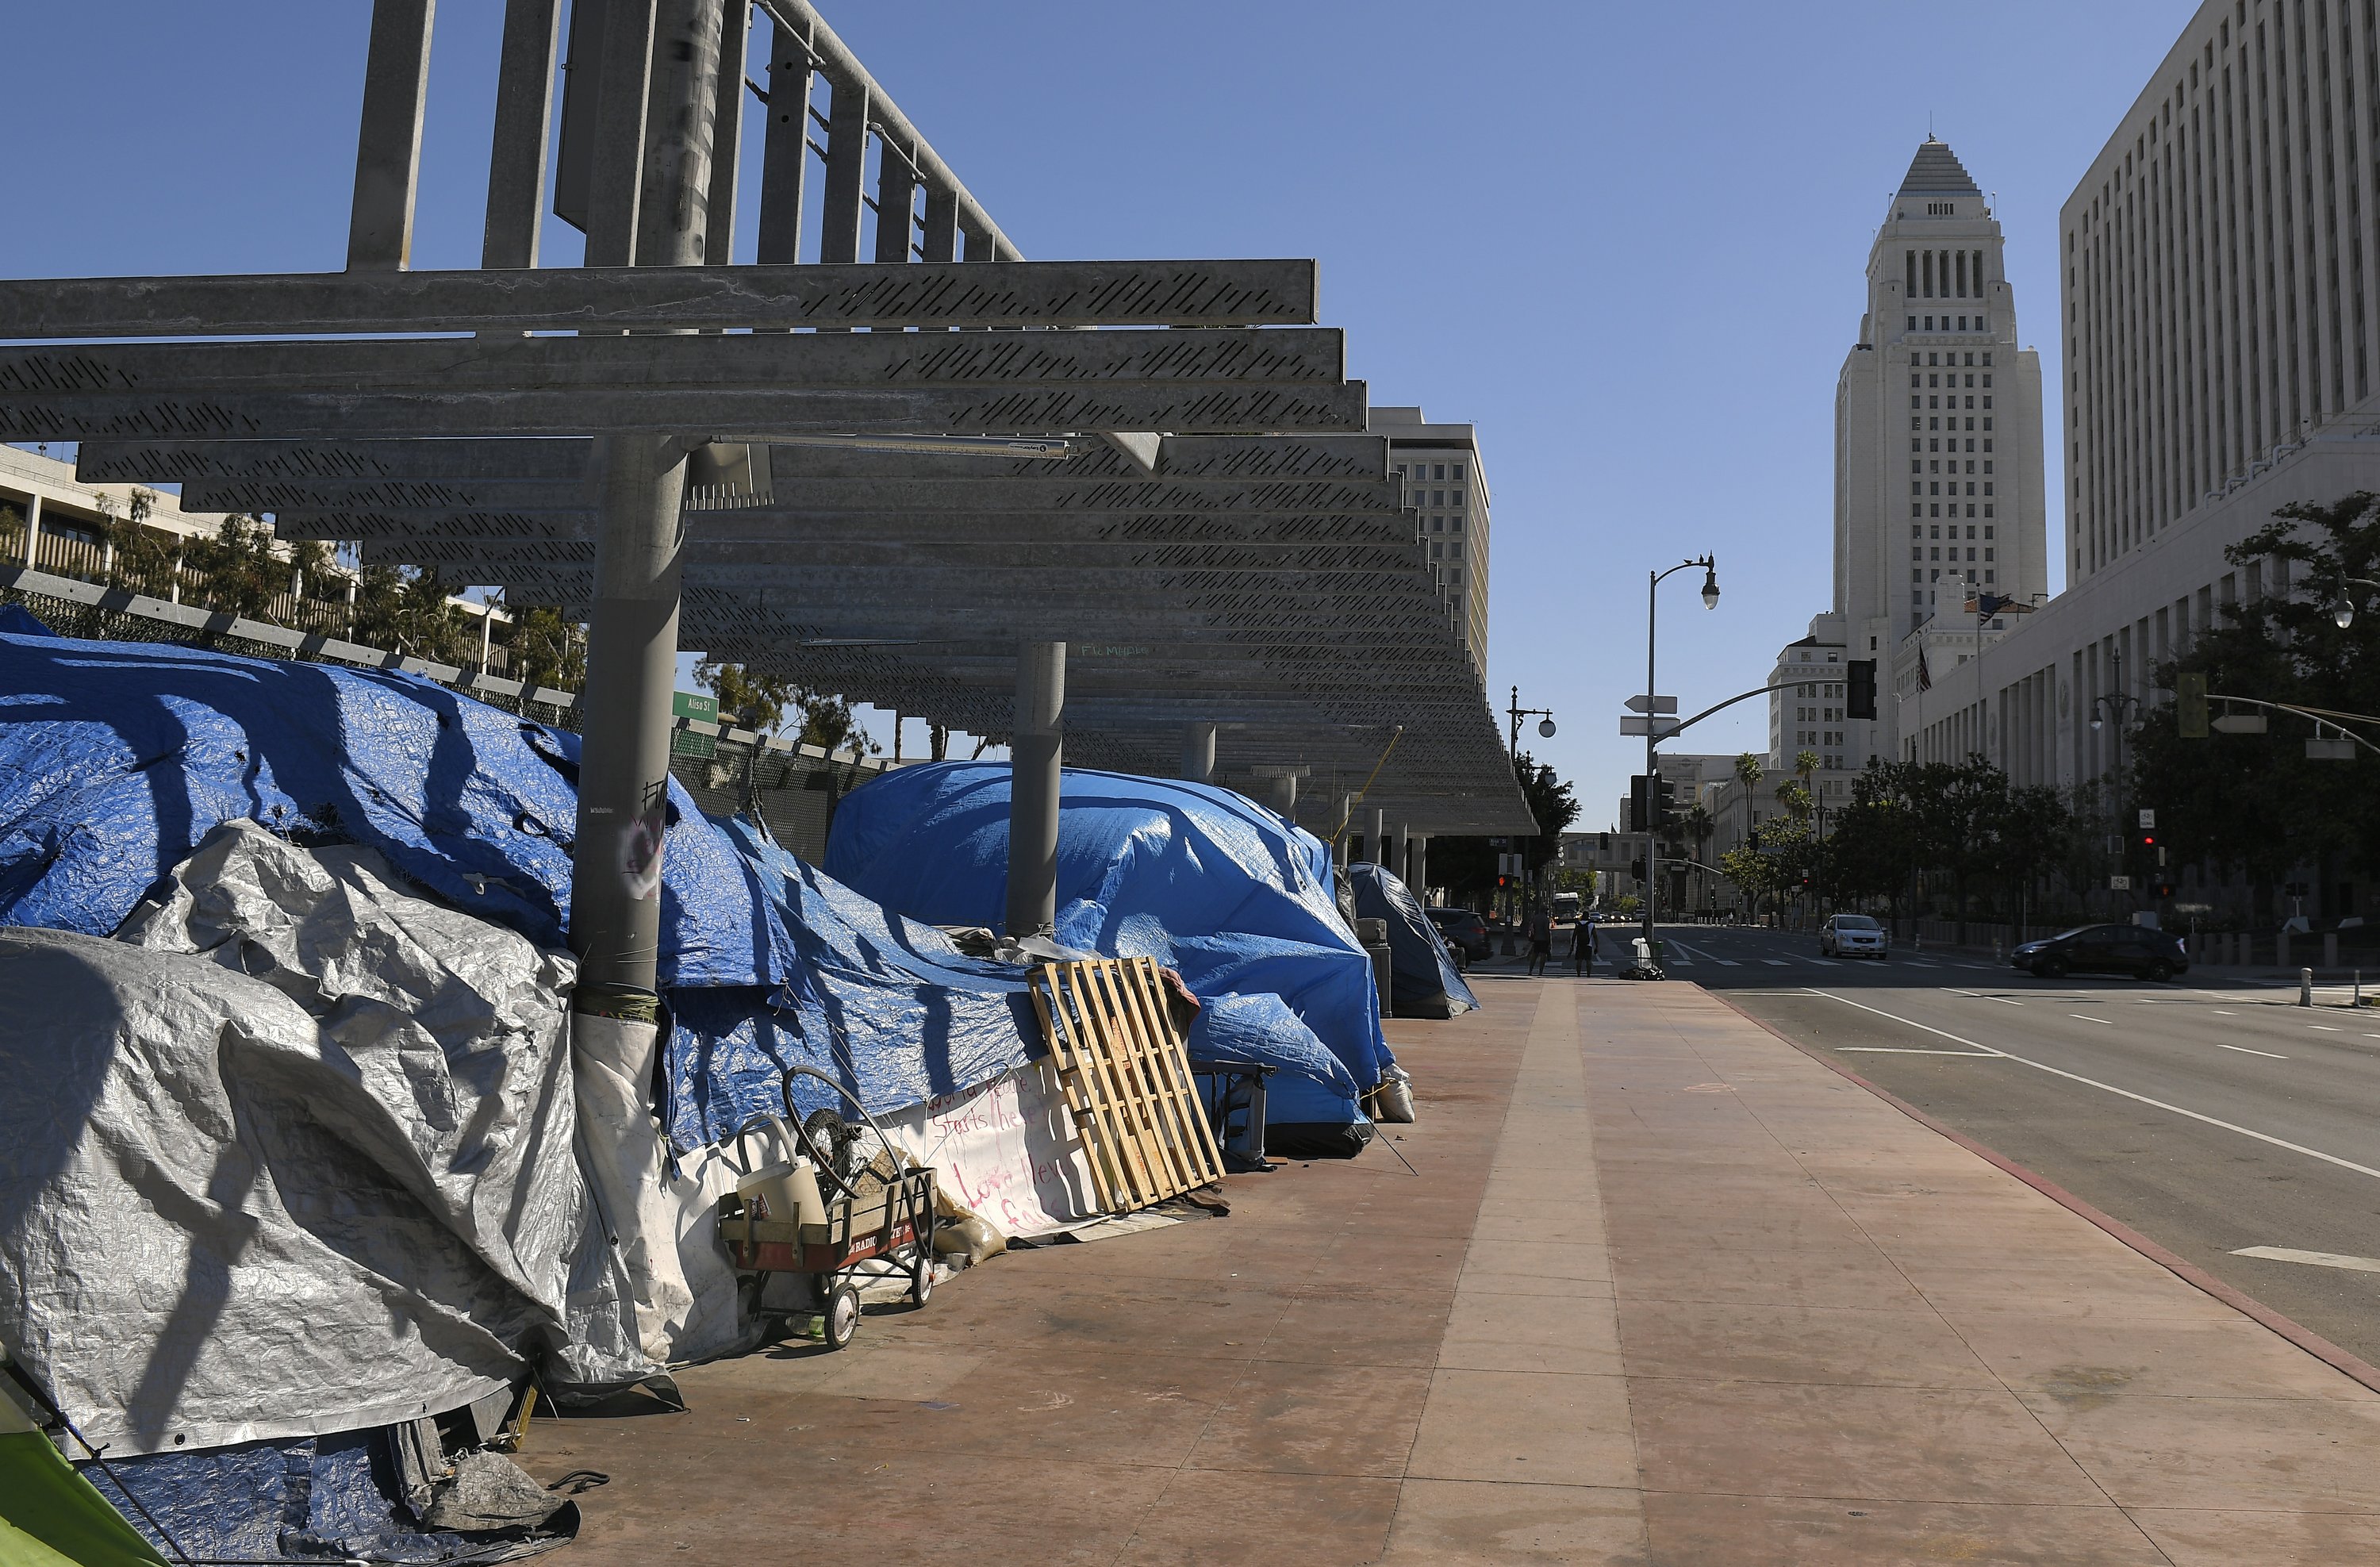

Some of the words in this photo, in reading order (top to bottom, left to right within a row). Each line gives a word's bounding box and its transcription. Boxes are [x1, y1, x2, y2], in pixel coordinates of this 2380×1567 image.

[688, 698, 703, 711] Aliso
[704, 701, 711, 712] St
[932, 1107, 988, 1139] Starts
[855, 1235, 877, 1253] RADIO
[890, 1226, 904, 1239] YER
